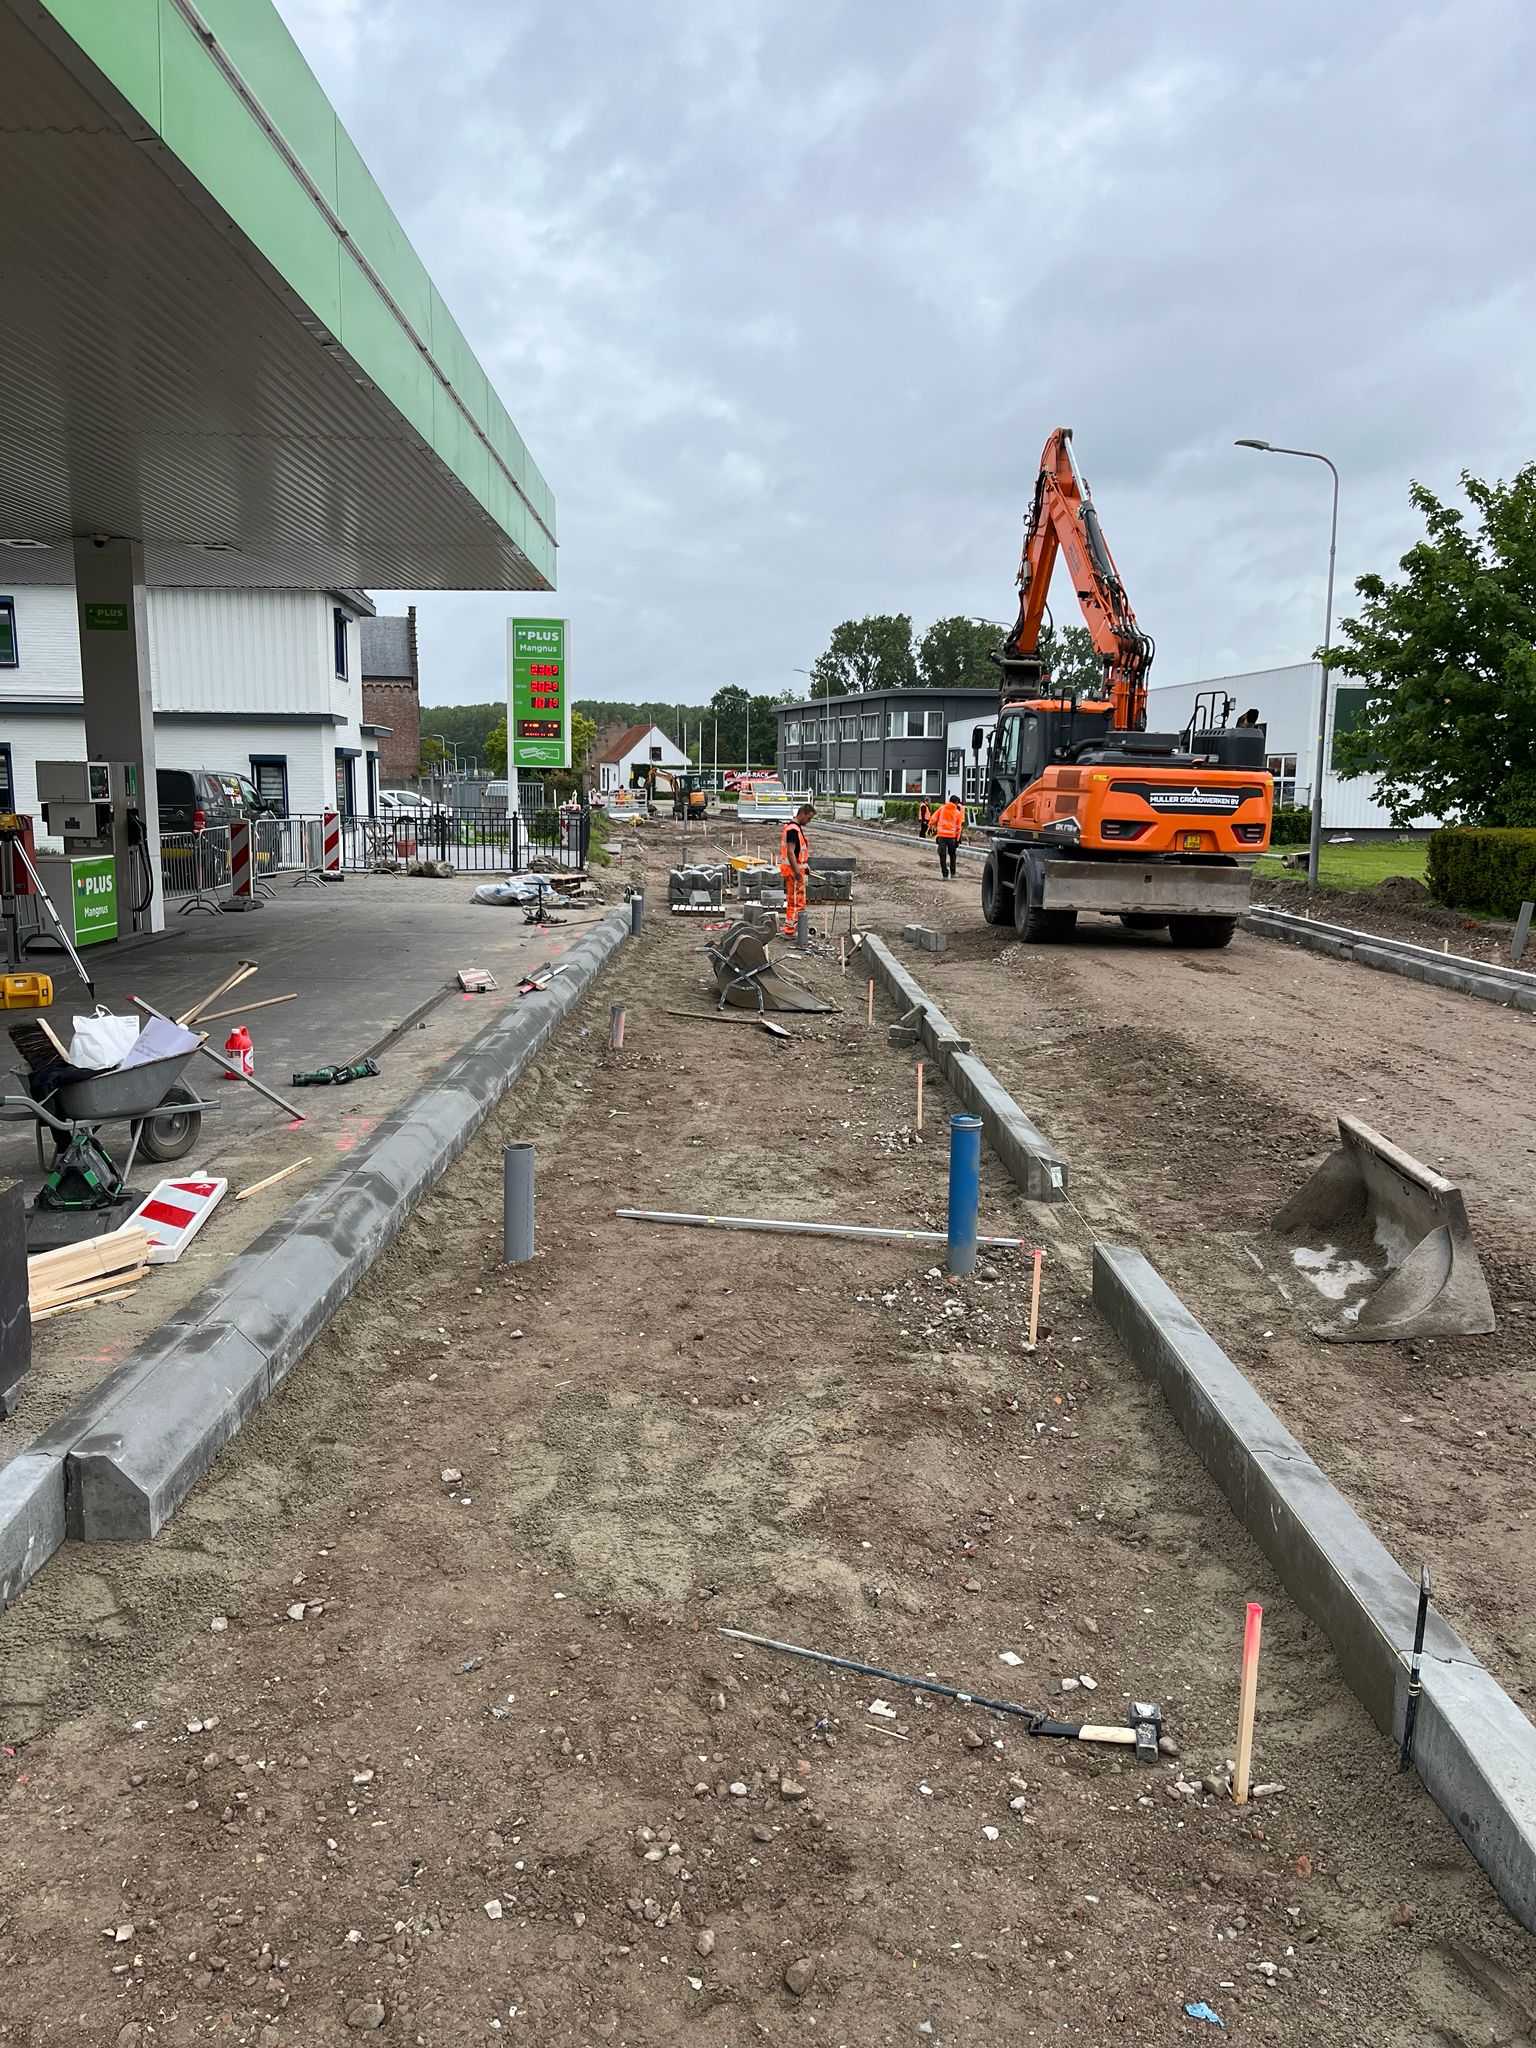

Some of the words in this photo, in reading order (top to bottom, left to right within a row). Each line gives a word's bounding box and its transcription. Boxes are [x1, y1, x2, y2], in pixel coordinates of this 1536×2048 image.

[527, 631, 559, 641] PLUS
[520, 644, 557, 653] Mangnus
[1180, 796, 1230, 805] GRONDWERKEN
[86, 874, 113, 896] PLUS
[84, 905, 109, 918] Mangnus
